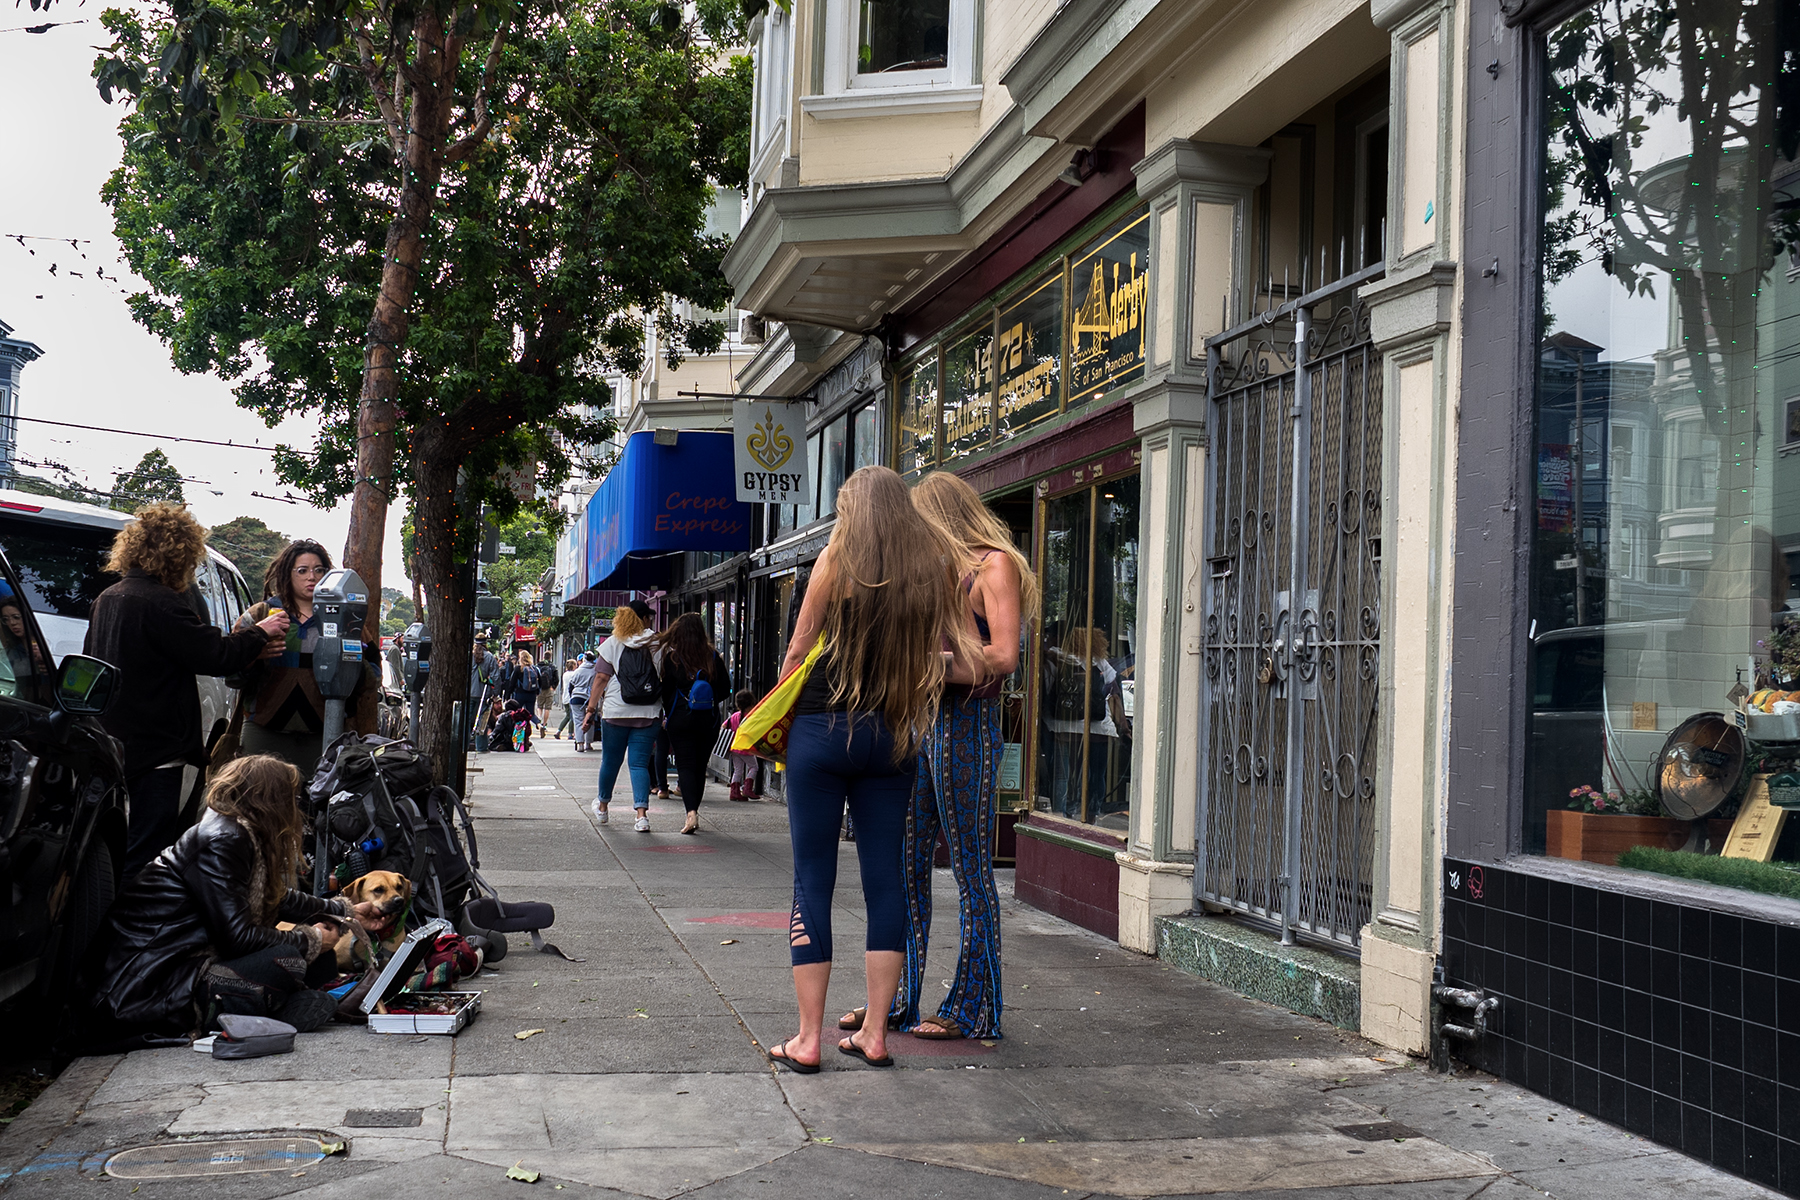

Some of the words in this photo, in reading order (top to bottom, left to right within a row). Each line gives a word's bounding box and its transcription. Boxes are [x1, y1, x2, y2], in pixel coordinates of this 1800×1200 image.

[1110, 252, 1149, 359] derby
[974, 322, 1023, 390] 1472
[1083, 369, 1090, 385] of
[1091, 366, 1102, 381] San
[1104, 351, 1134, 374] Francisco
[744, 472, 802, 492] GYPSY
[666, 492, 733, 514] Crepe
[759, 491, 787, 501] MEN
[655, 514, 743, 536] Express
